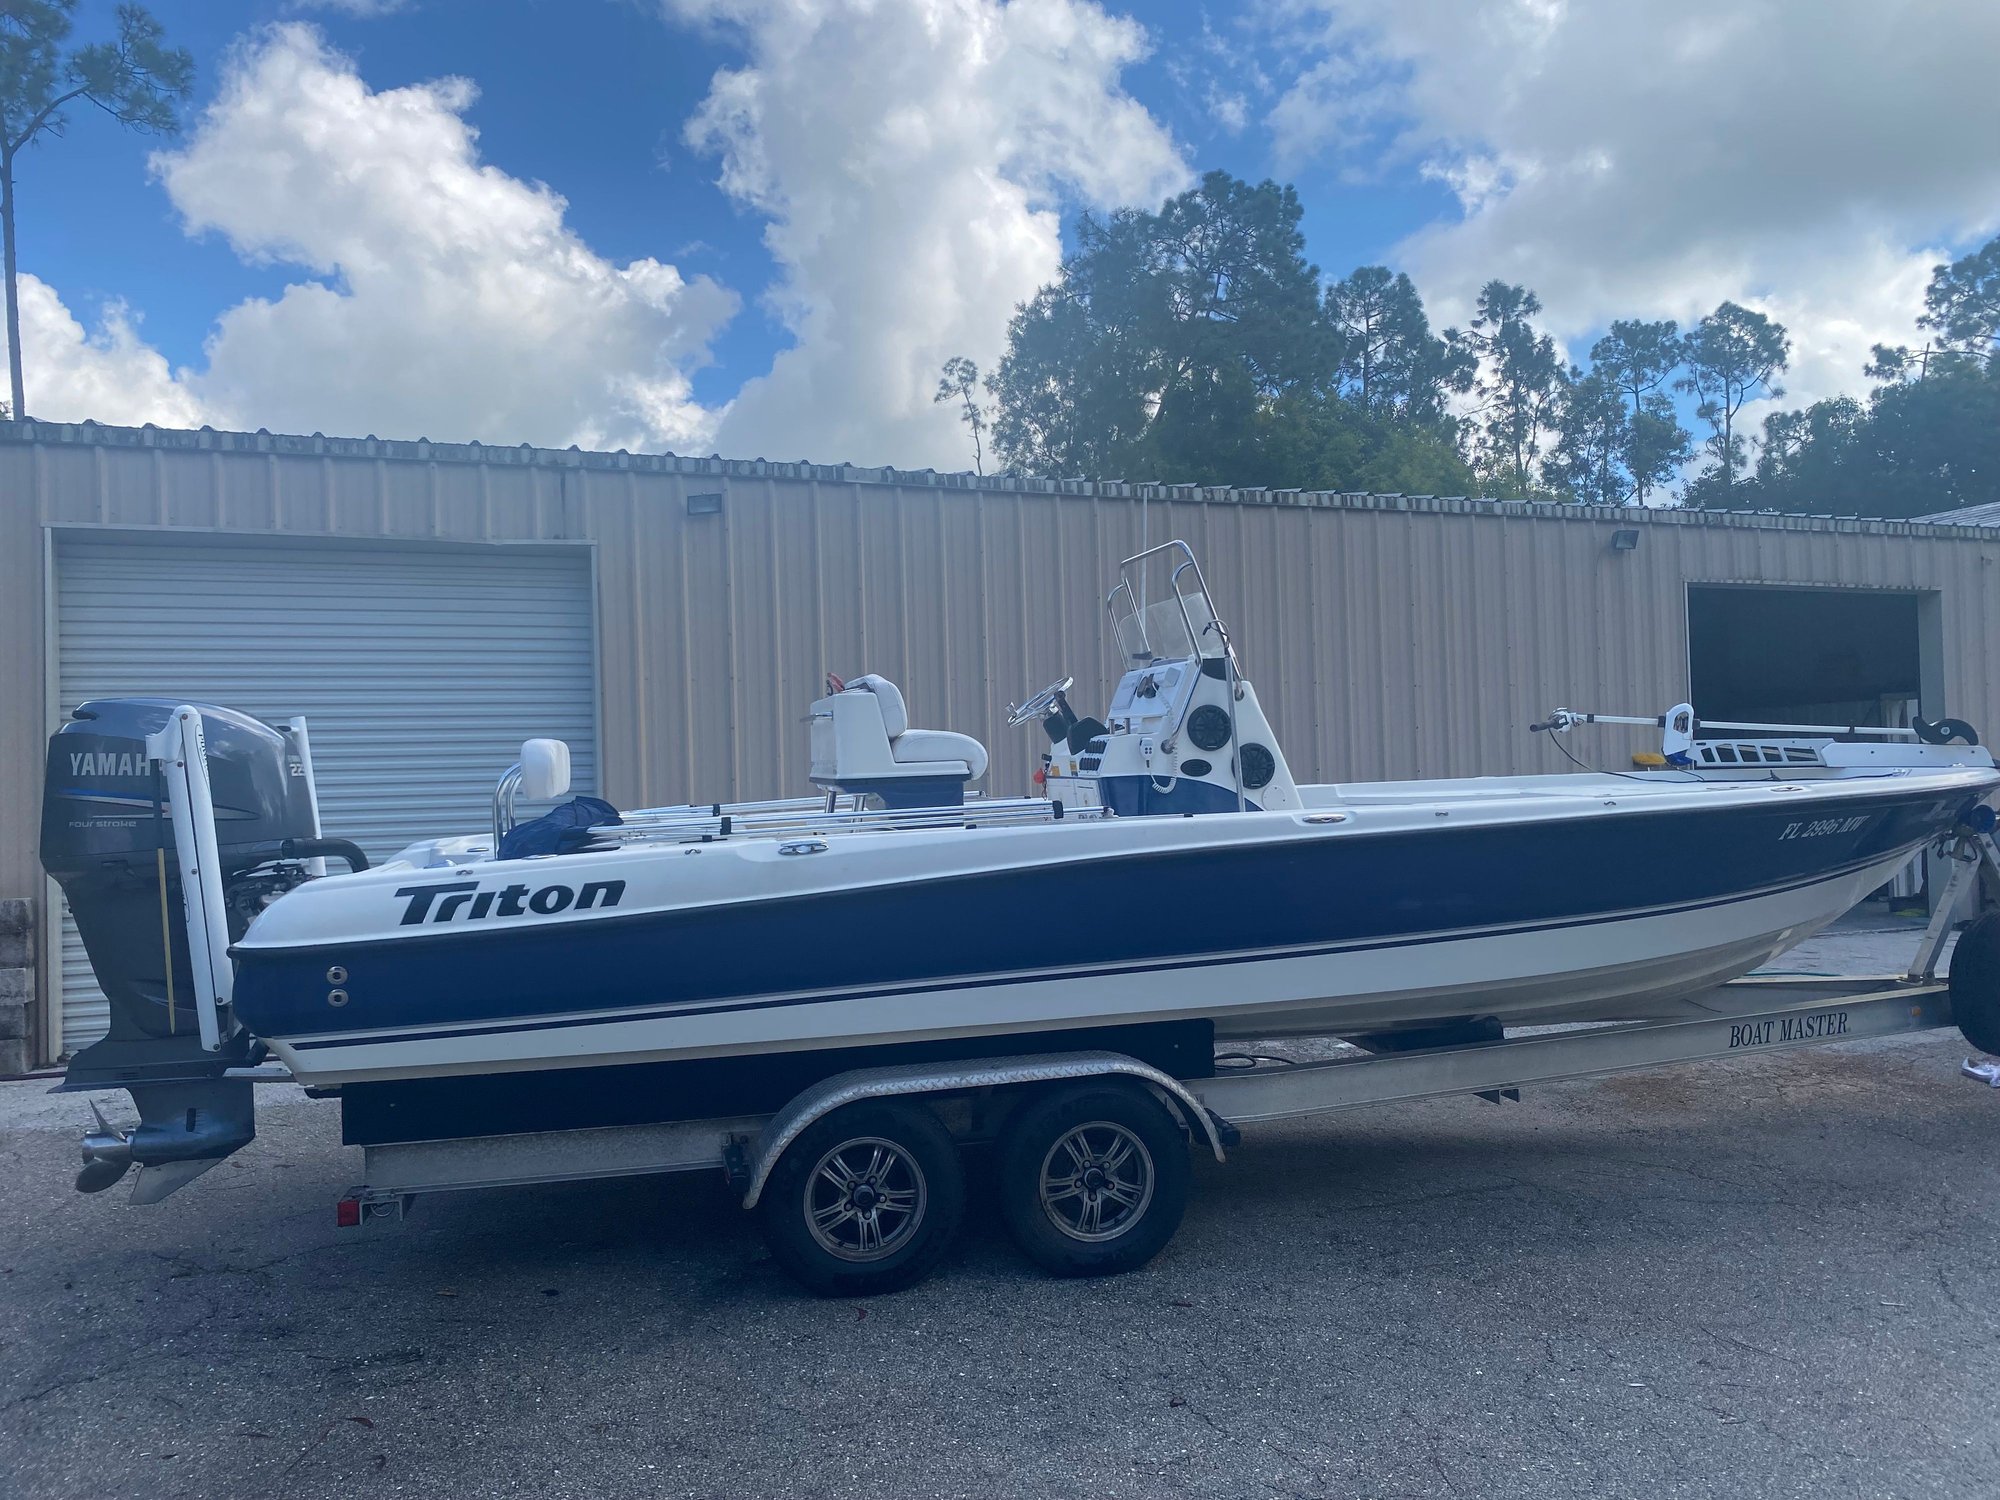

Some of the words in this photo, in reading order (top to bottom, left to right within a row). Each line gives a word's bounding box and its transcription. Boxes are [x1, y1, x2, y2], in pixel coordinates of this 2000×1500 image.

[289, 763, 305, 777] 22
[1778, 822, 1803, 840] FL
[1801, 819, 1843, 838] 2996
[1838, 815, 1871, 833] MW
[394, 880, 626, 925] Triton
[1728, 1020, 1775, 1048] BOAT
[1778, 1012, 1848, 1042] MASTER
